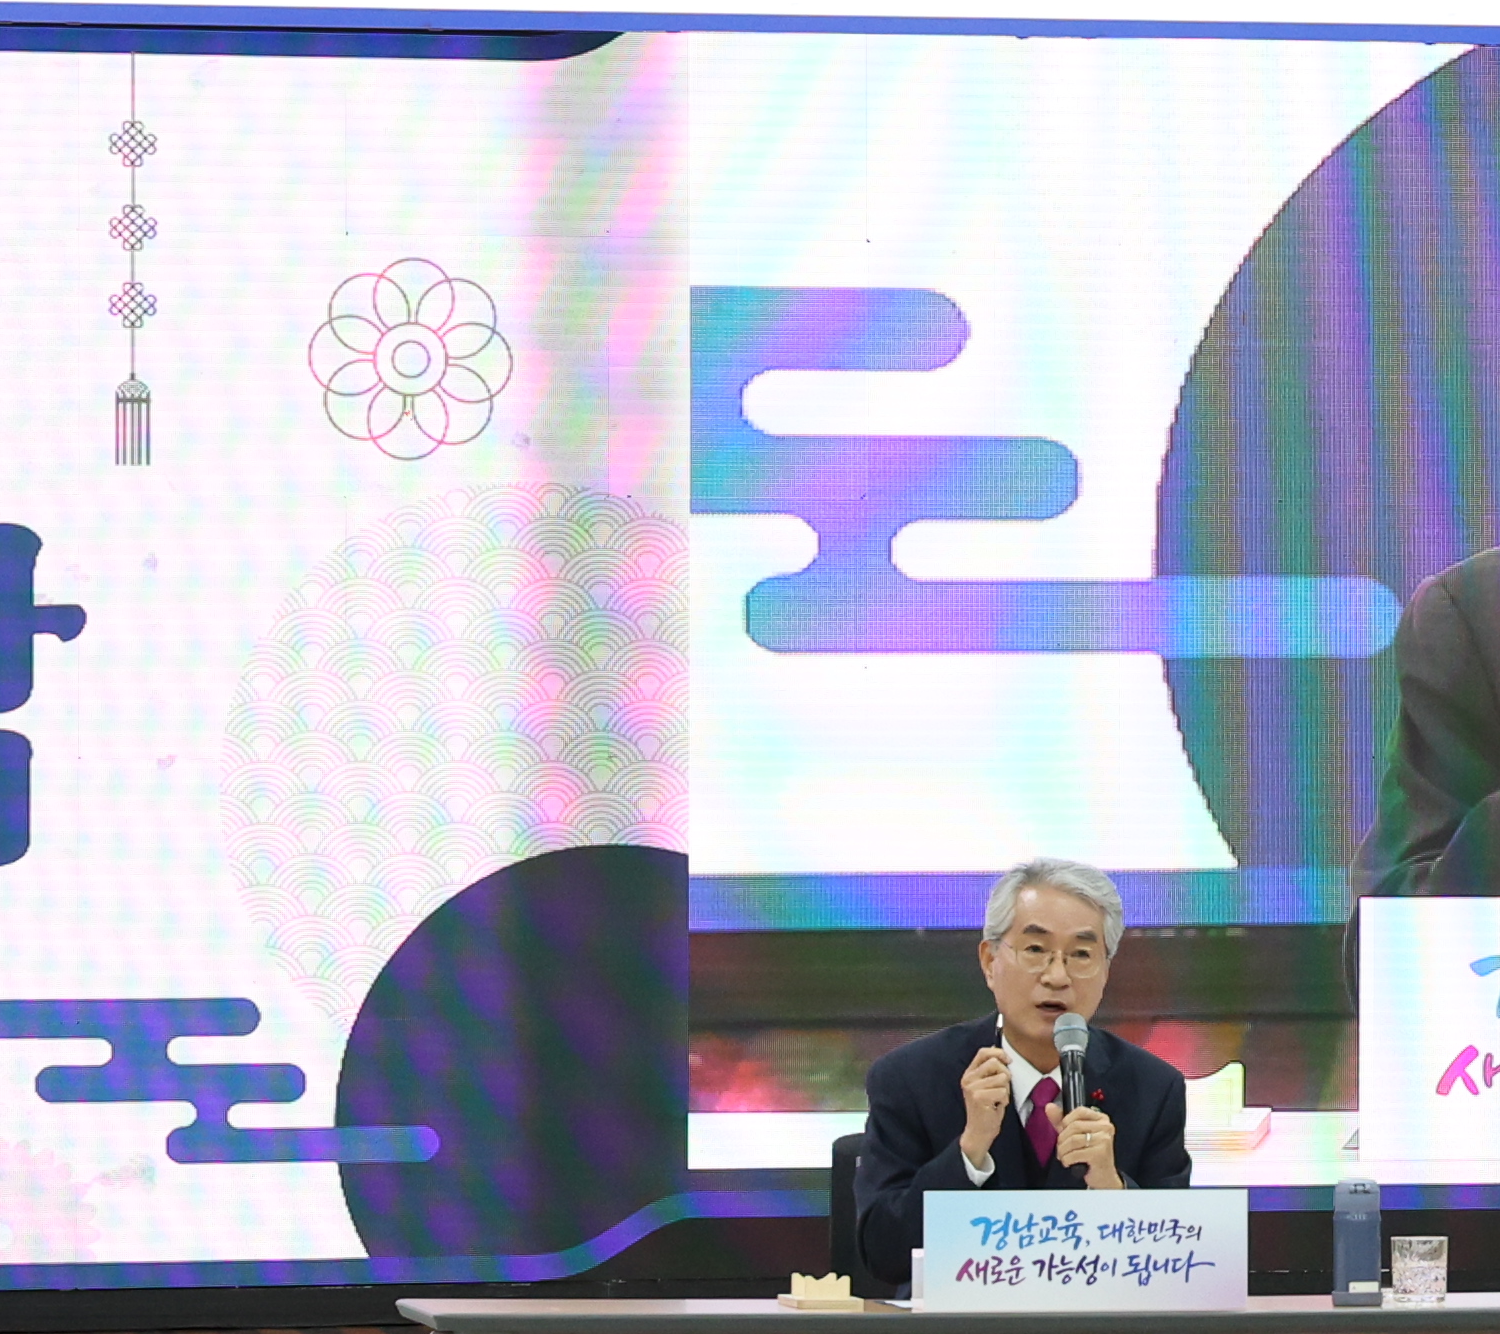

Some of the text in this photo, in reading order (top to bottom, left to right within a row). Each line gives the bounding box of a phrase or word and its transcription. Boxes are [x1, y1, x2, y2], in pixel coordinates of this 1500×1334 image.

[970, 1210, 1202, 1250] 경남교육, 대한민국의
[956, 1250, 1215, 1286] 새로운 가능성이 됩니다
